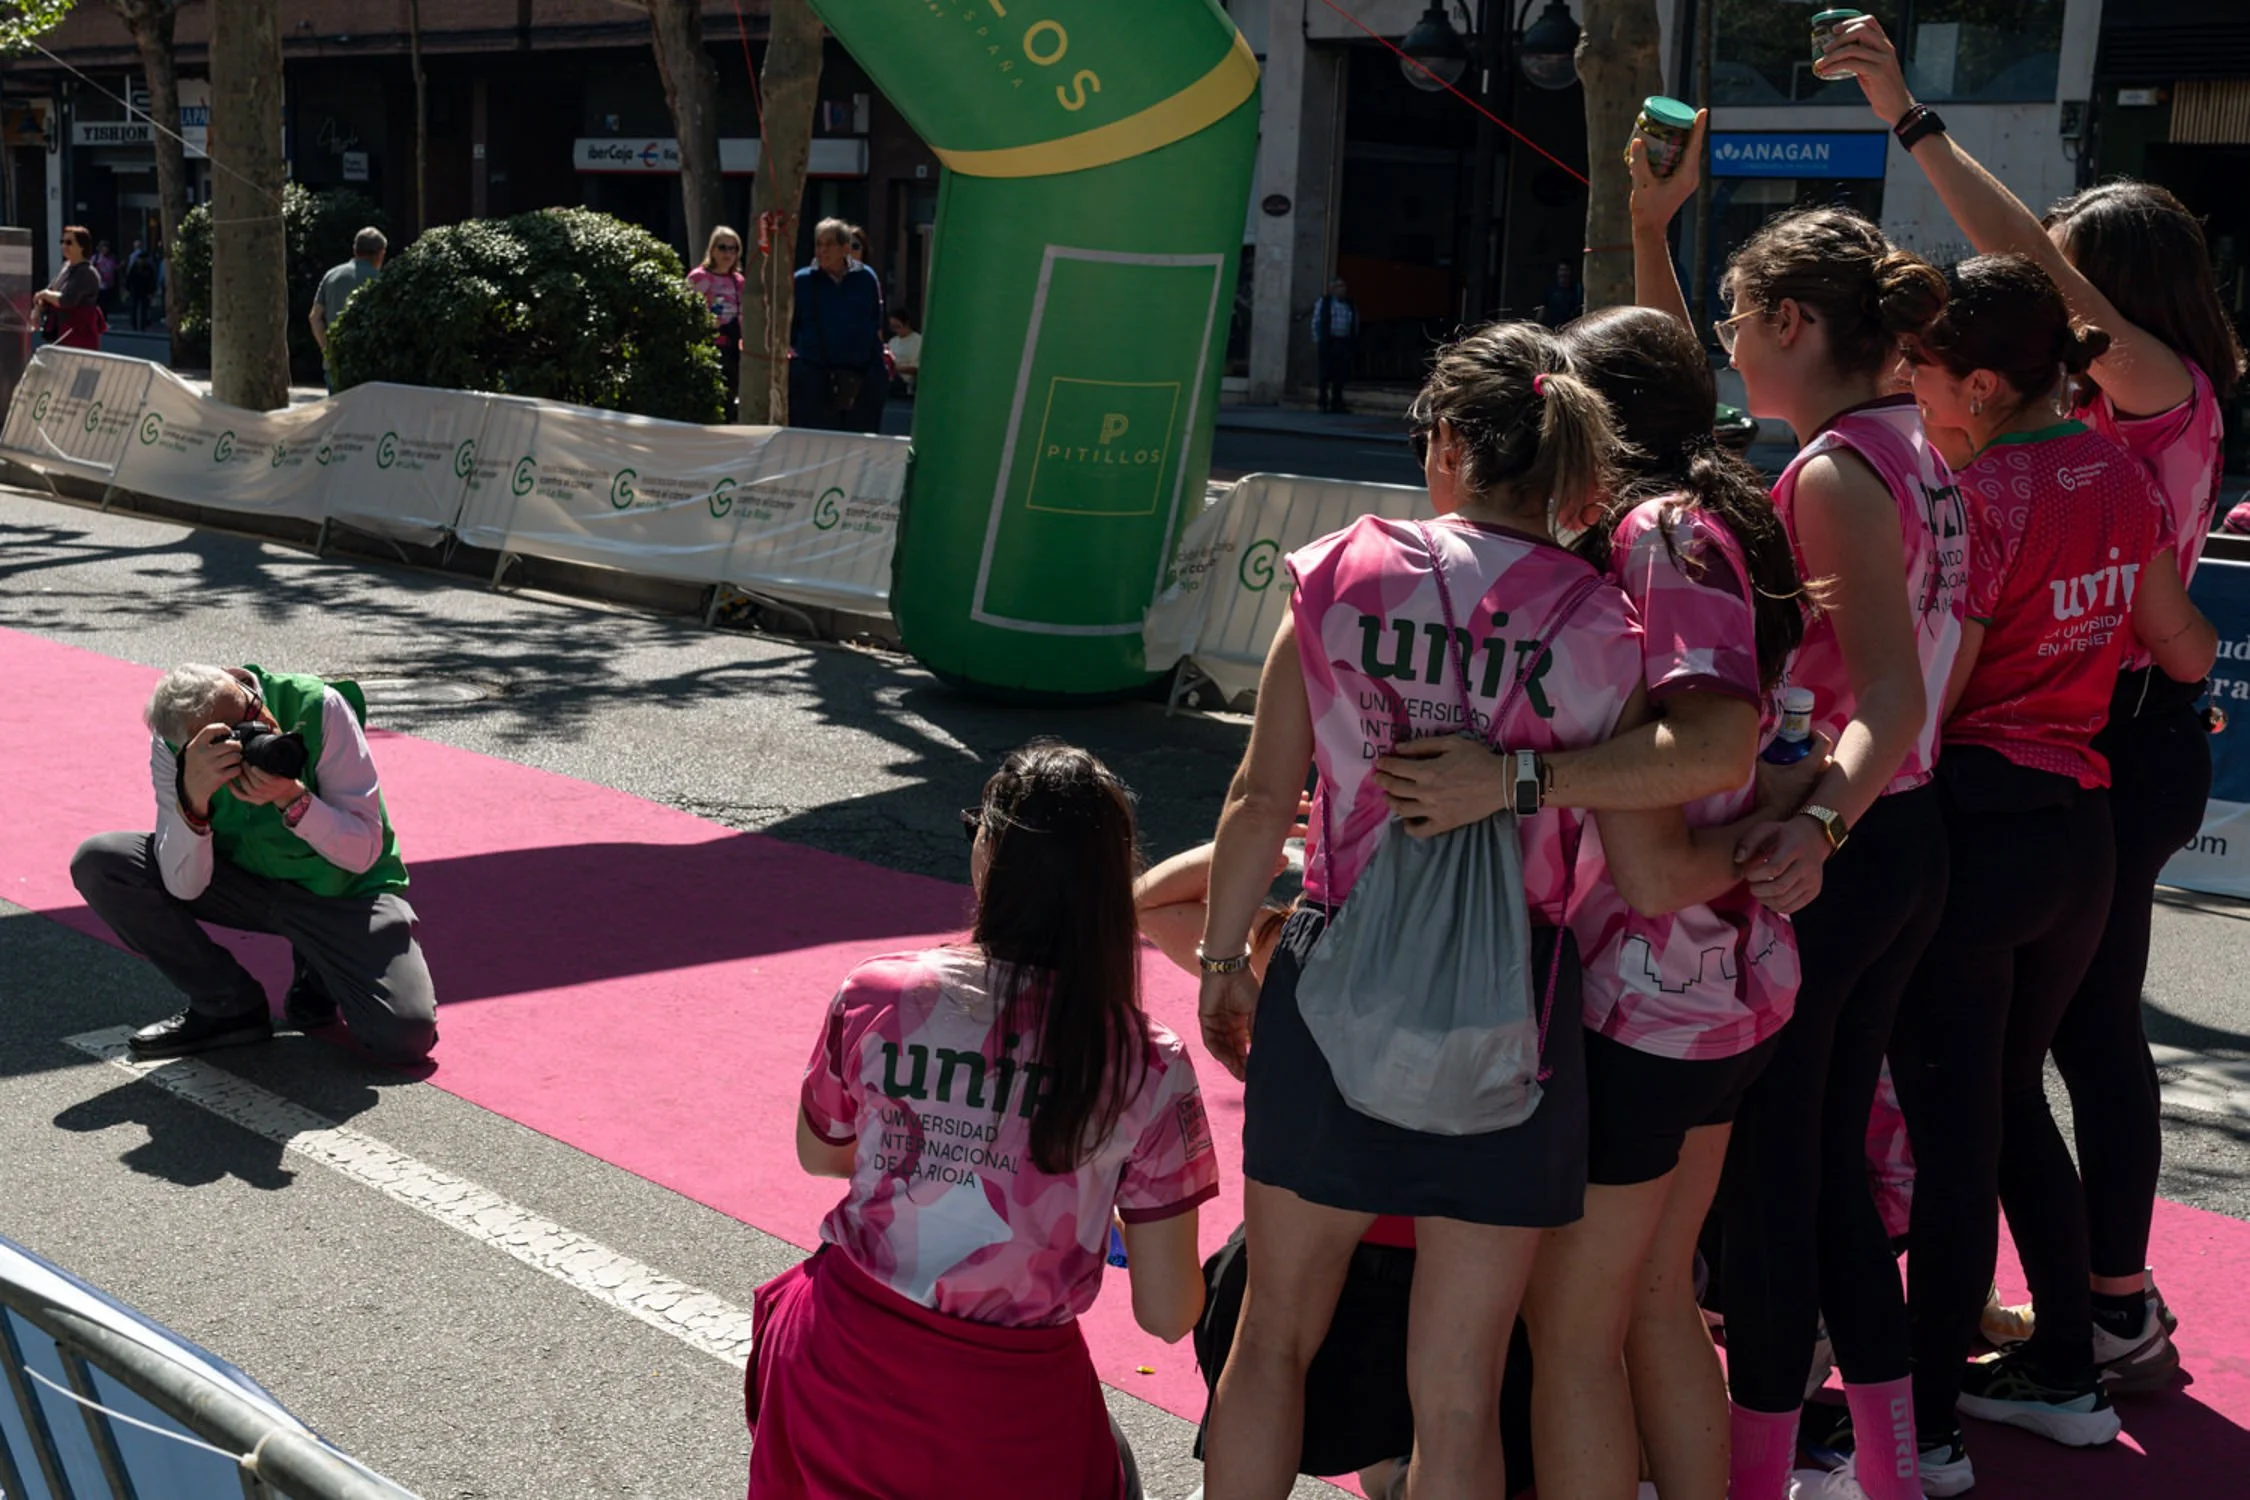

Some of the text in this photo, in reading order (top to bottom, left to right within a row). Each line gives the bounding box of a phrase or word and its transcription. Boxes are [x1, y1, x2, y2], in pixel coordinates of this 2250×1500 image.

[949, 0, 1024, 90] SPAÑA
[1740, 142, 1830, 162] ANAGAN
[1047, 444, 1161, 465] PITILLOS
[880, 1104, 999, 1143] UNIVERSIDAD
[873, 1153, 898, 1173] DE
[924, 1163, 976, 1189] RIOJA
[879, 1131, 1019, 1175] NTERNACIONAL
